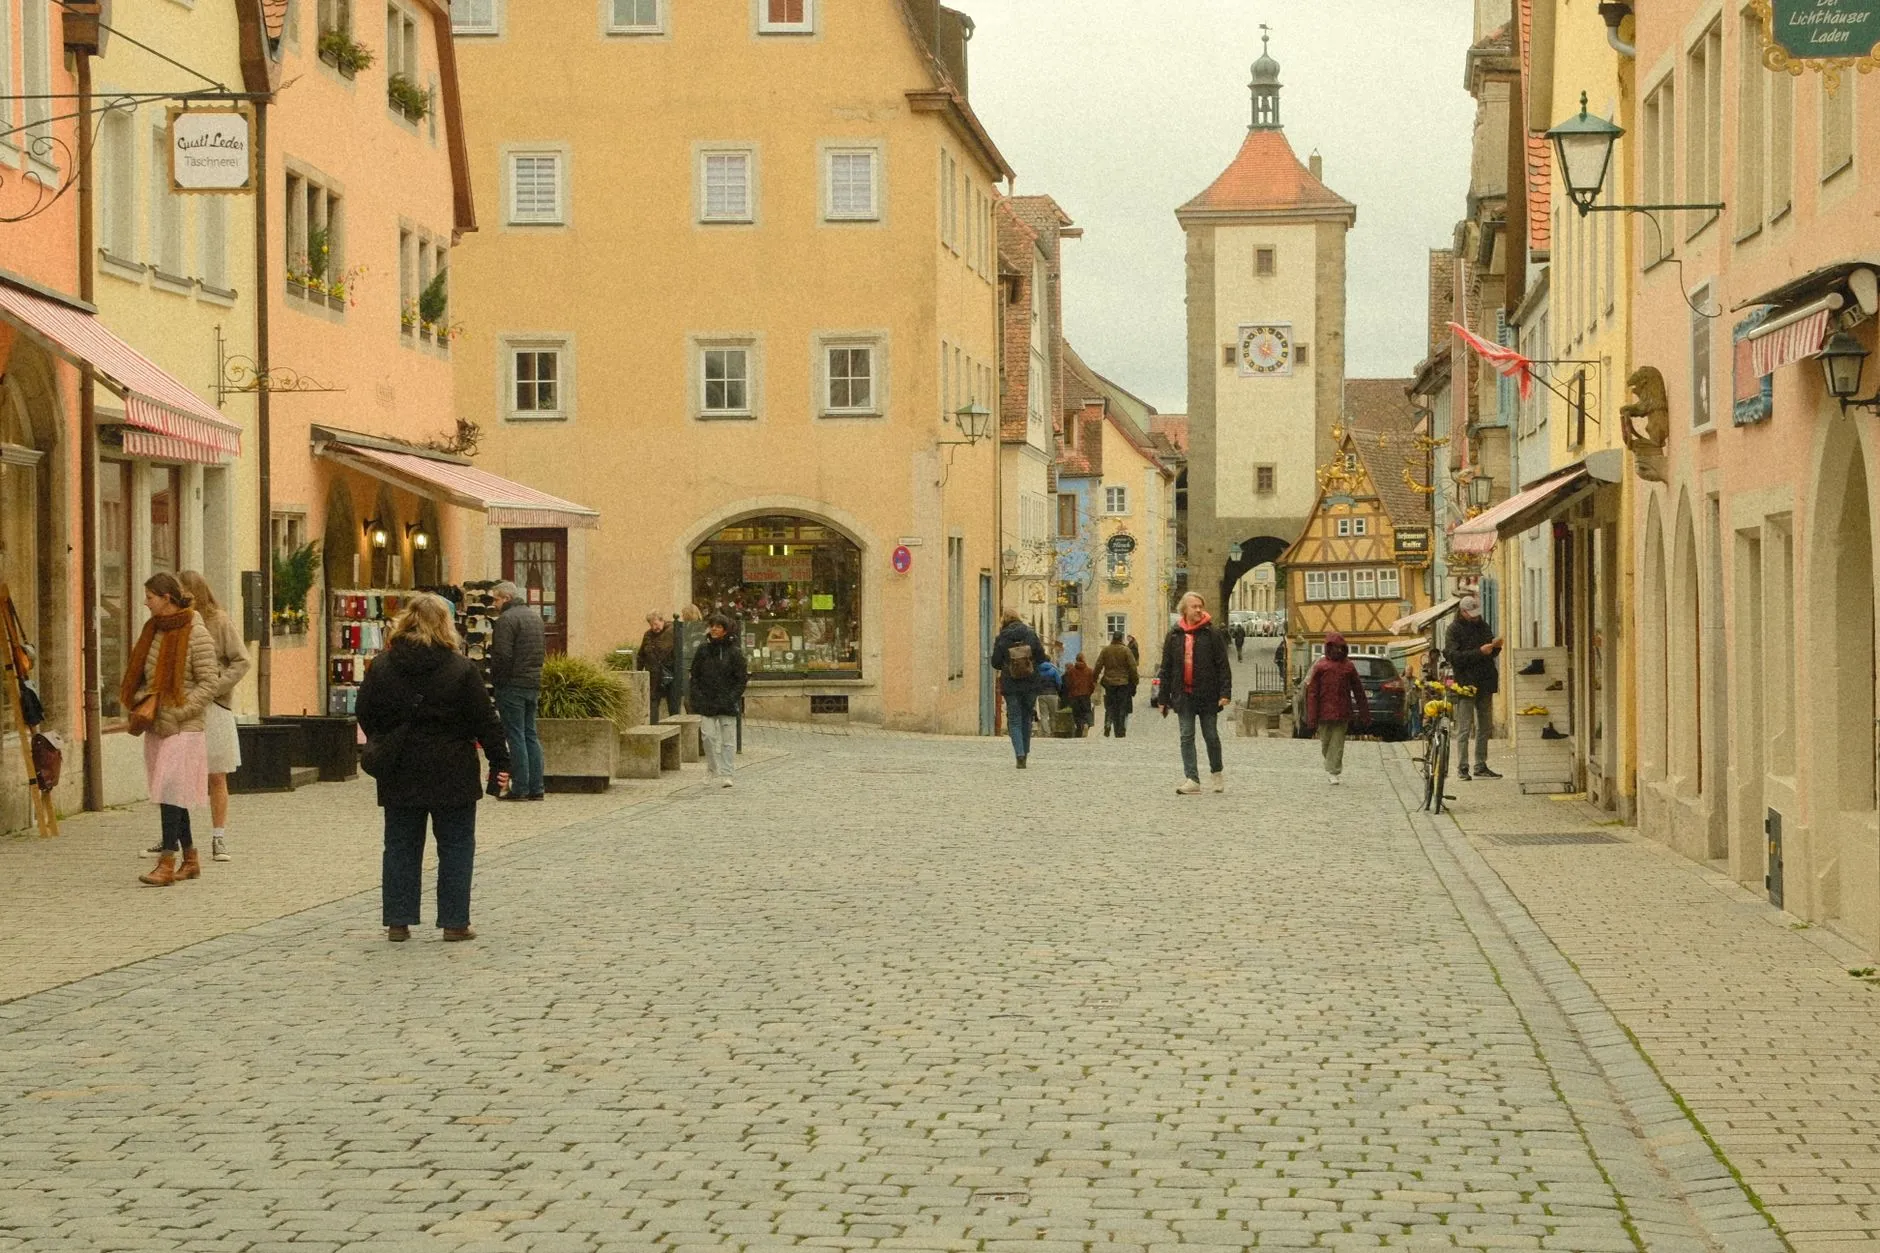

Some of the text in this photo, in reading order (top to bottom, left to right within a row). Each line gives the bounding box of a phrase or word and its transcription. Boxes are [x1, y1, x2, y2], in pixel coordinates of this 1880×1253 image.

[1788, 9, 1871, 25] Lichthäuser
[1810, 28, 1850, 43] Laden
[177, 132, 244, 150] Gusti Leder
[184, 155, 240, 168] Taschnerei
